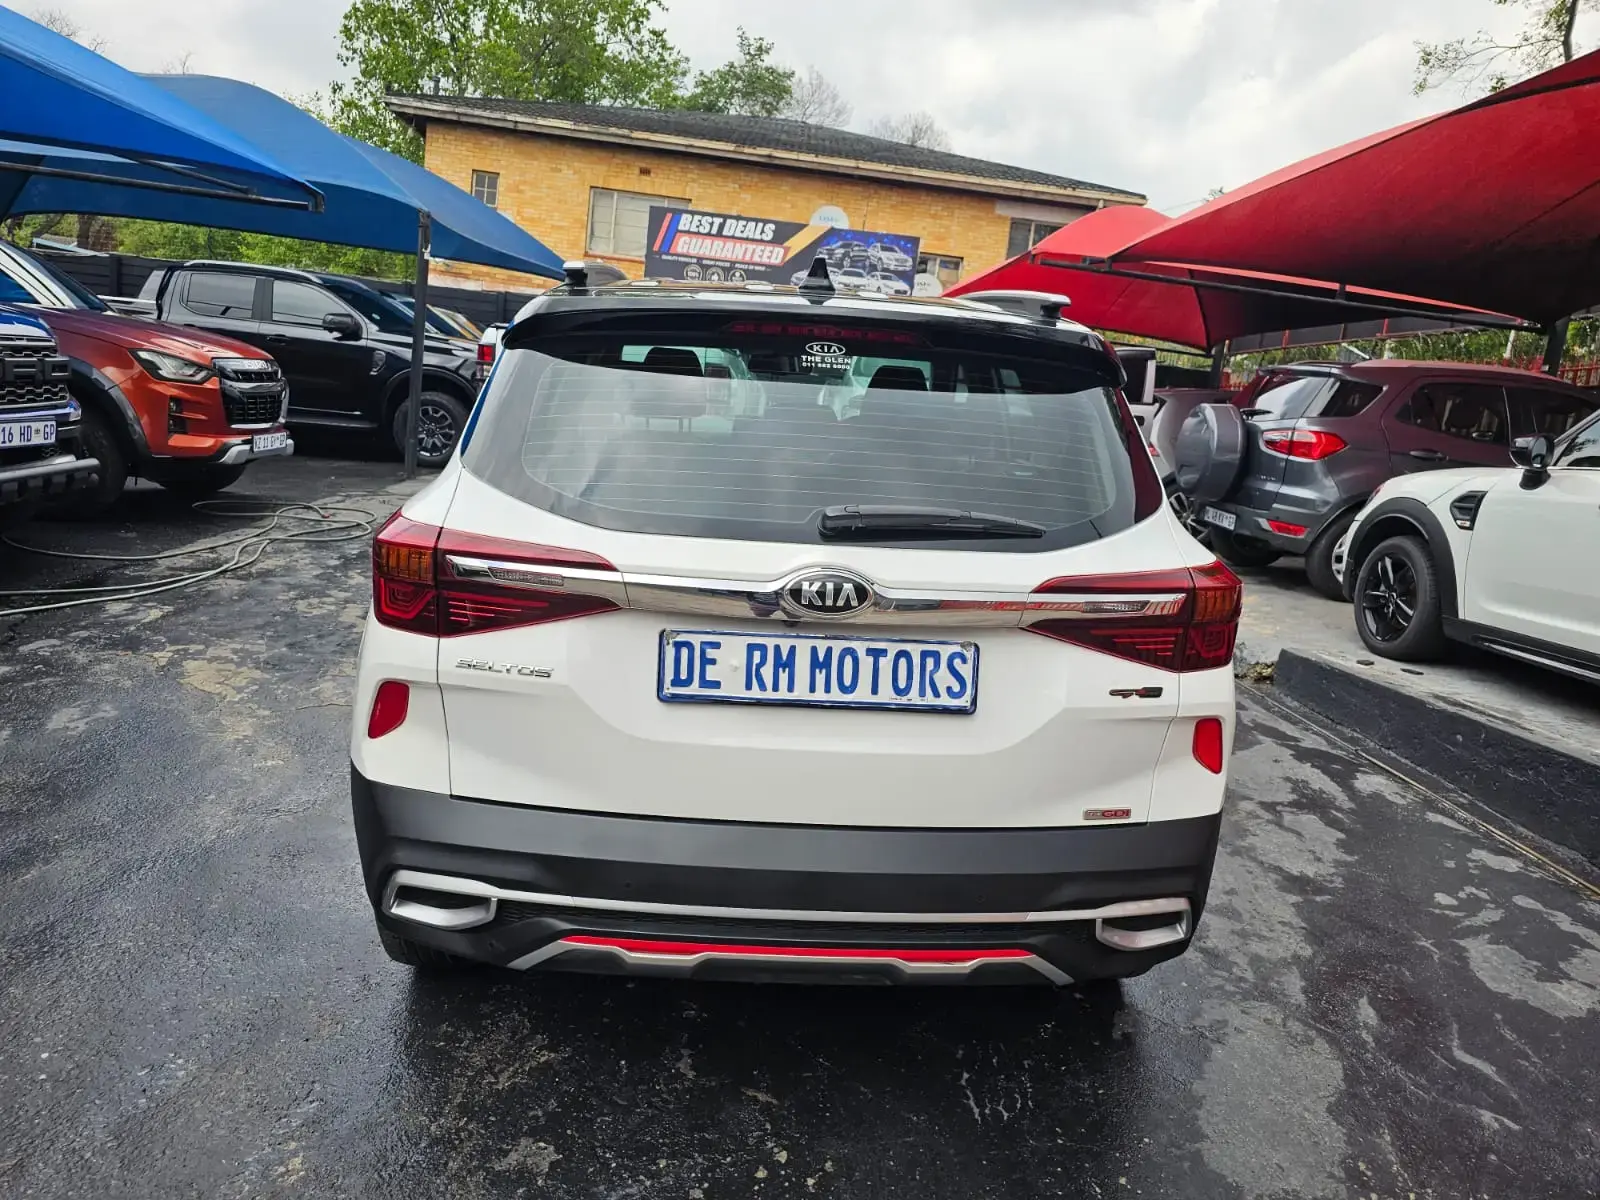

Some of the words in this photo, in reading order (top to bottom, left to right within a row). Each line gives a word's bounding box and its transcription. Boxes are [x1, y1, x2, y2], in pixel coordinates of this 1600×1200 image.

[678, 213, 723, 235] BEST
[722, 218, 776, 241] DEALS
[677, 235, 785, 264] GUARANTEED
[812, 344, 840, 353] KIA
[824, 356, 851, 364] GLEN
[1, 425, 14, 444] 16
[20, 425, 32, 443] HD
[43, 424, 55, 441] GP
[800, 581, 859, 607] KIA
[455, 657, 554, 678] SELTOS
[670, 640, 722, 690] DE
[745, 642, 797, 692] RM
[809, 645, 969, 699] MOTORS
